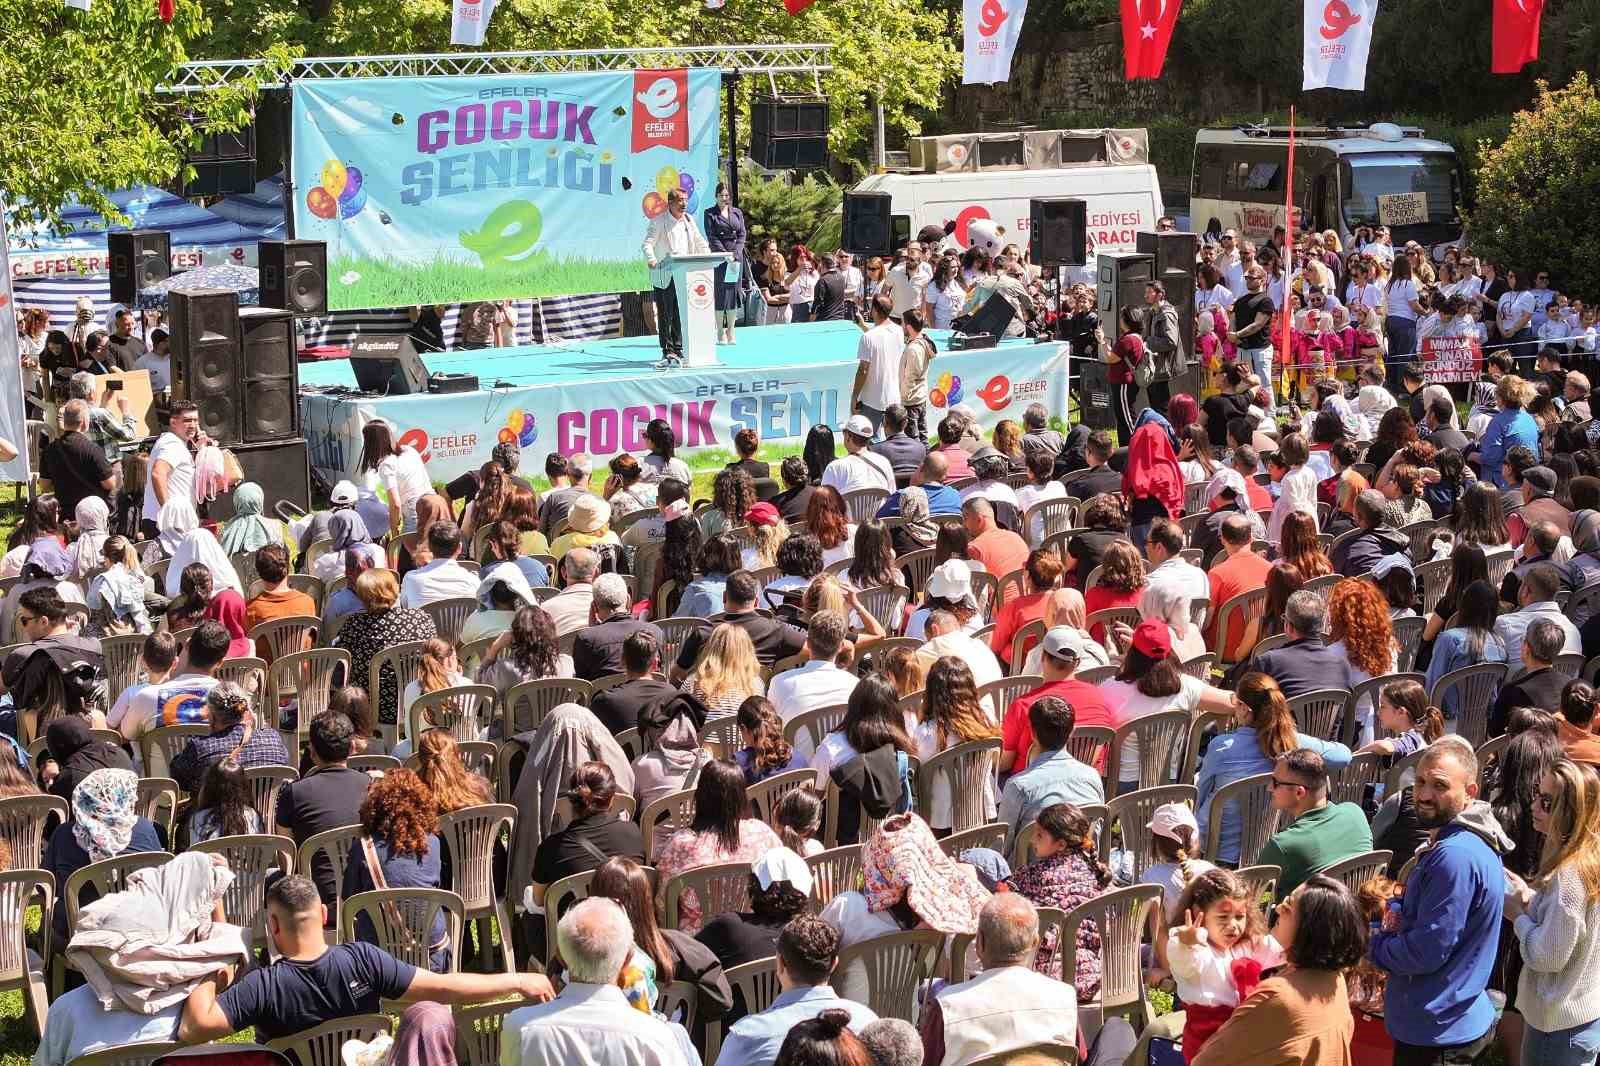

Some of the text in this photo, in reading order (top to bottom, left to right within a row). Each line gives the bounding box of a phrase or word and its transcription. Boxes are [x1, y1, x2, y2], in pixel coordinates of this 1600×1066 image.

[478, 87, 548, 99] EFELER
[416, 100, 599, 154] ÇOCUK
[645, 122, 675, 132] EFELER
[696, 379, 780, 397] EFELER
[1013, 380, 1047, 394] EFELER
[432, 434, 477, 449] EFELER
